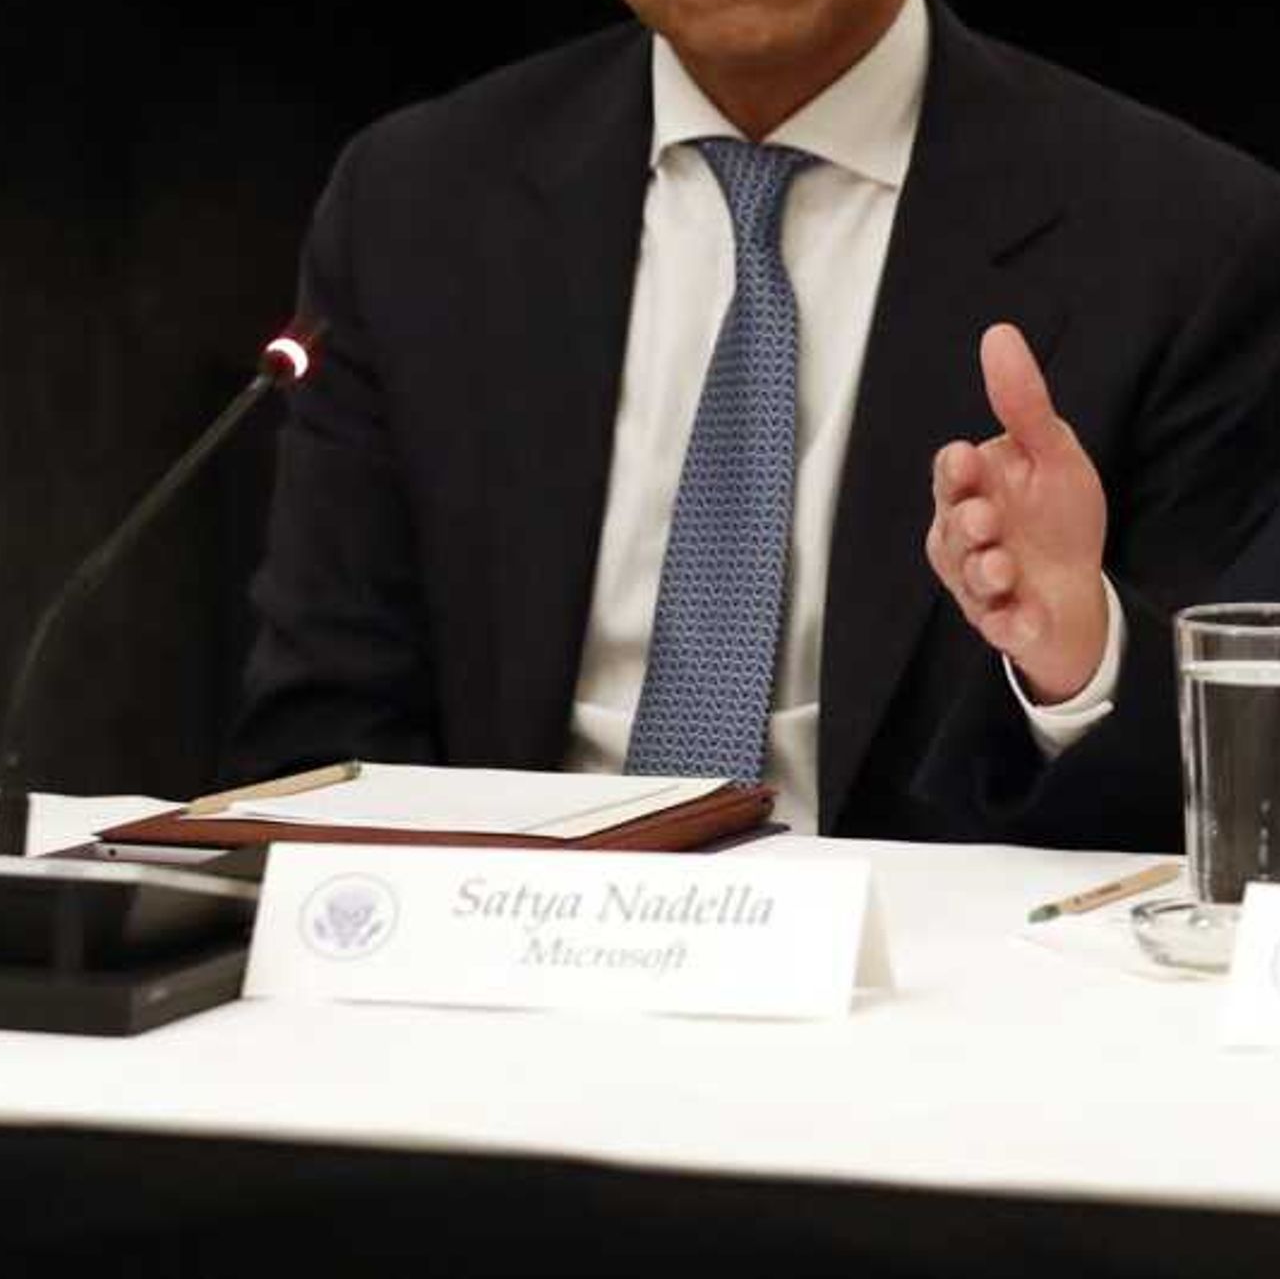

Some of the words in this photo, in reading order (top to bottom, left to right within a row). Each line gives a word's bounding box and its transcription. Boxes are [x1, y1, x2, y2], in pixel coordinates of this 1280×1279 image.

[451, 877, 581, 931] Satya
[596, 881, 776, 926] Nadella
[519, 936, 688, 973] Microsoft
